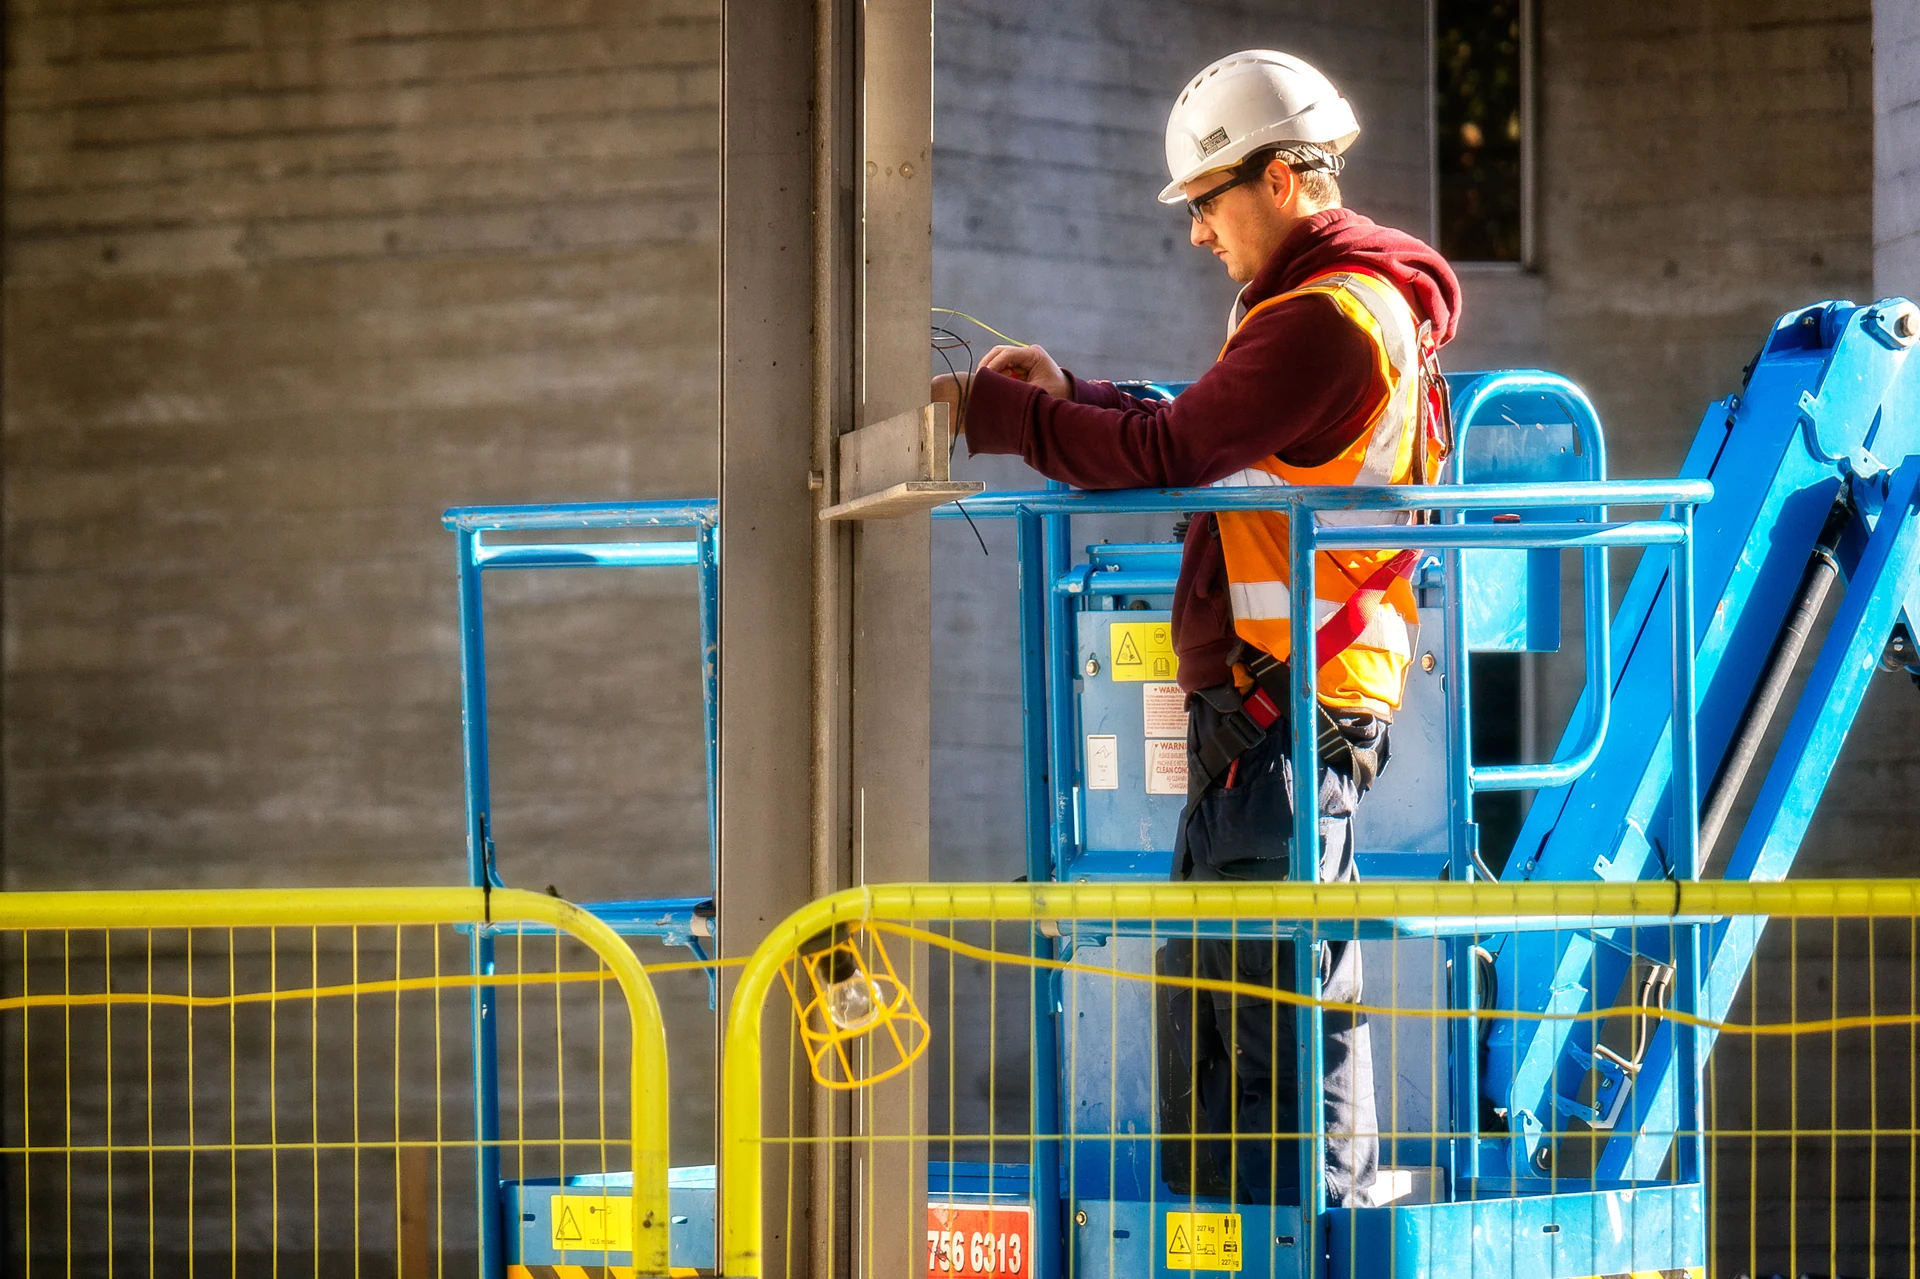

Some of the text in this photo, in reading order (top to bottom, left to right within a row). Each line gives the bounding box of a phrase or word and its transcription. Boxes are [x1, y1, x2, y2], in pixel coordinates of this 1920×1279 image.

[1208, 1225, 1215, 1234] kg
[928, 1231, 1021, 1274] 756 6313
